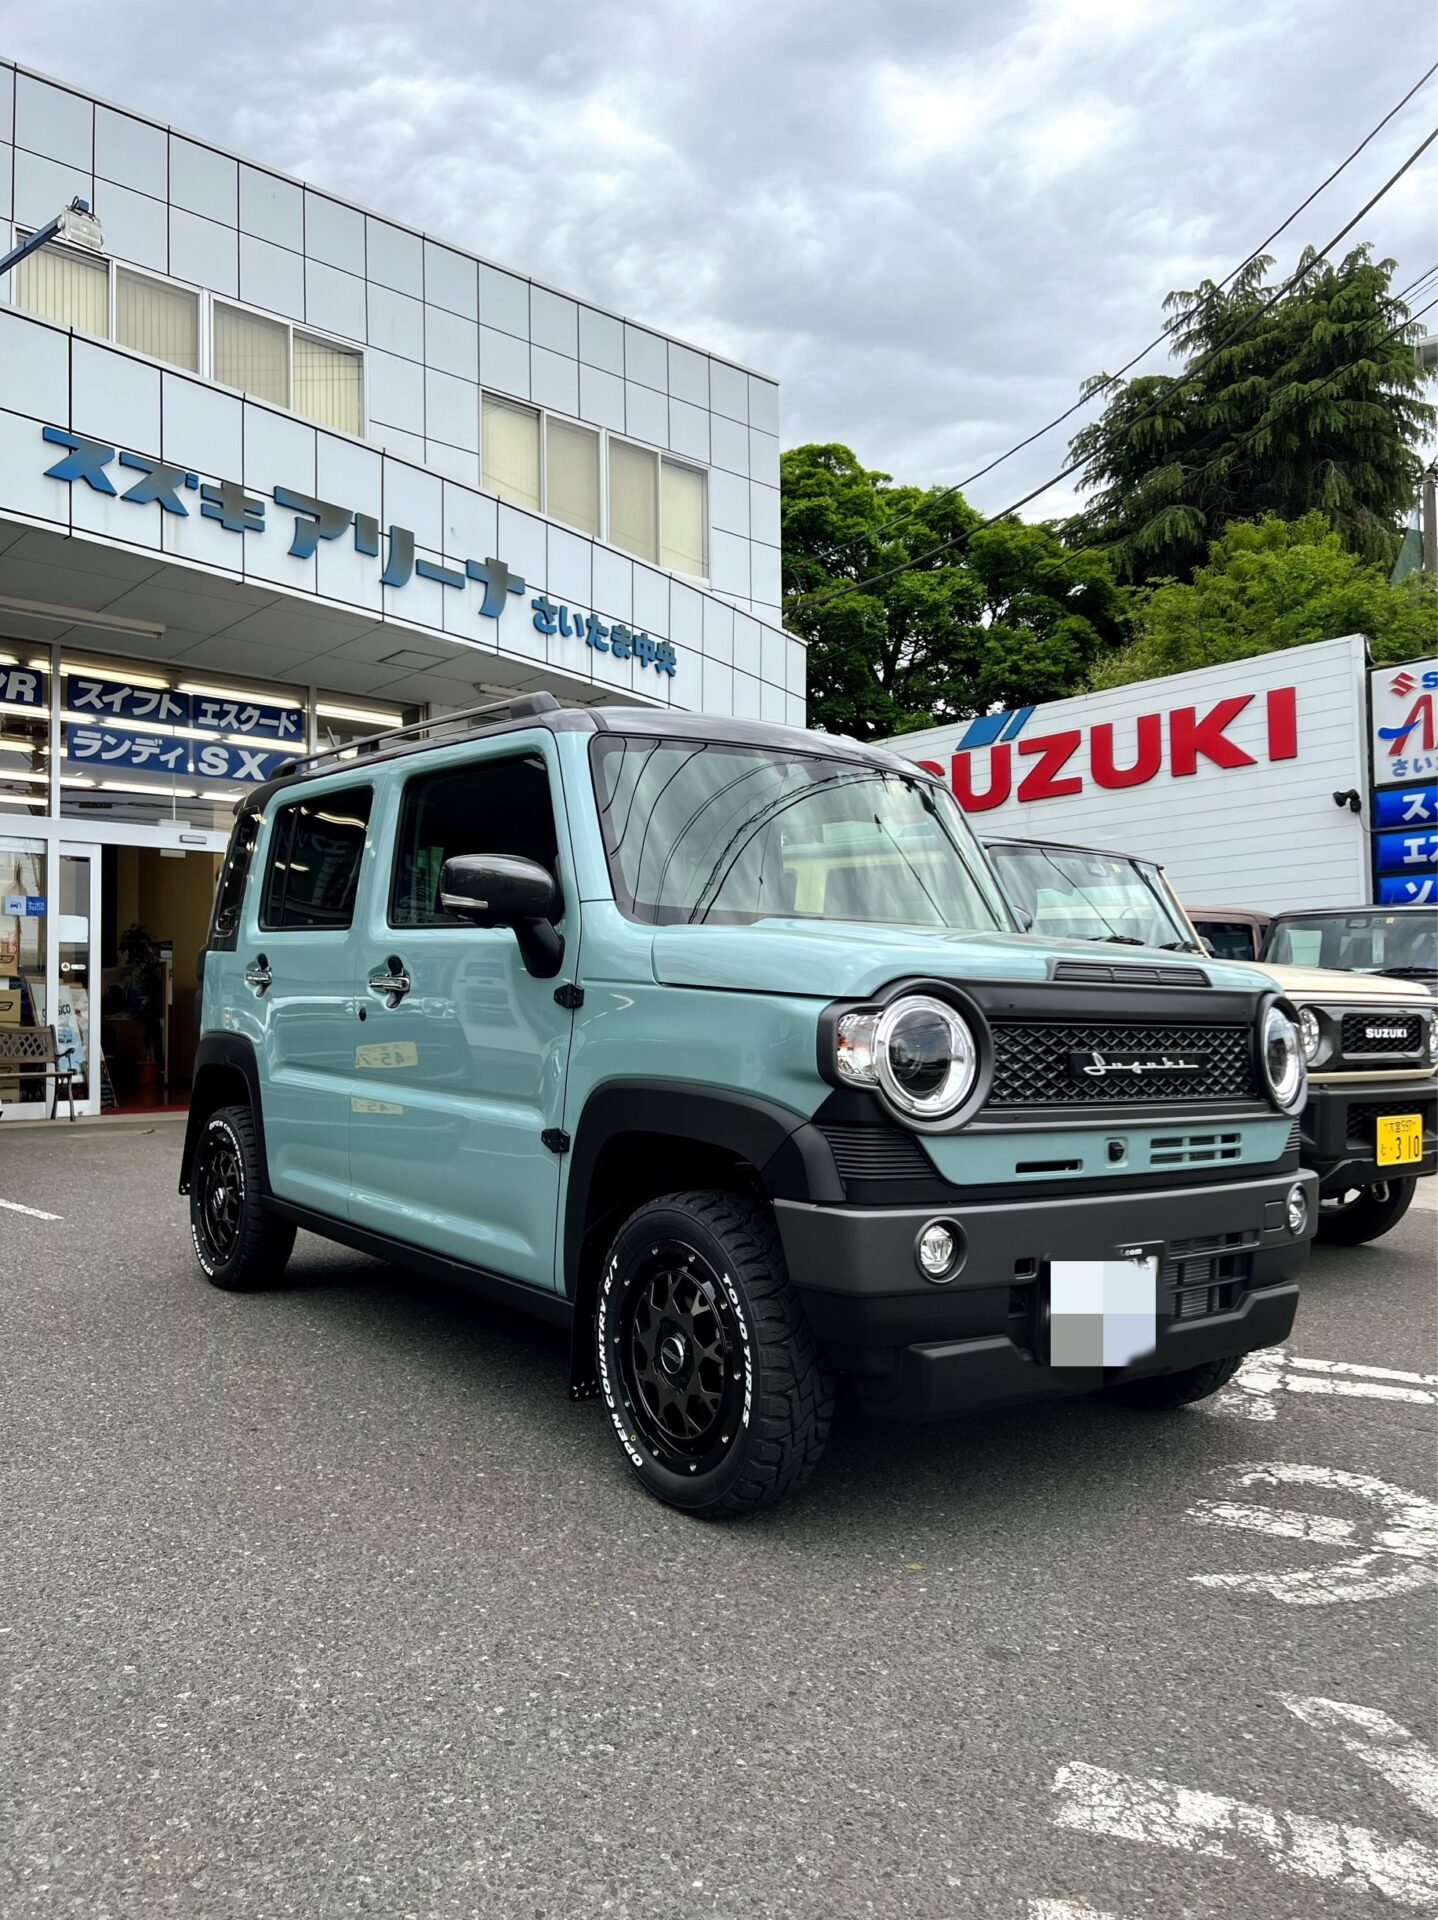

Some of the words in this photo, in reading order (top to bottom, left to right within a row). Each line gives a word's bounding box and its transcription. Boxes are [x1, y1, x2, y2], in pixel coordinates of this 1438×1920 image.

[42, 426, 526, 619] スズキアリーナ
[531, 596, 677, 677] さいたま中央
[0, 671, 37, 702] R
[73, 681, 183, 719] スイフト
[198, 702, 298, 737] エスクード
[73, 730, 184, 769] ランディ
[198, 746, 296, 781] SX
[917, 686, 1297, 812] UZUKI
[1365, 1028, 1408, 1039] SUZUKI
[1083, 1052, 1199, 1076] Suzuki
[603, 1253, 619, 1296] R/T
[598, 1297, 616, 1409] COUNTRY
[722, 1273, 749, 1341] TOYO
[743, 1345, 753, 1429] TIRES
[611, 1413, 643, 1467] OPEN
